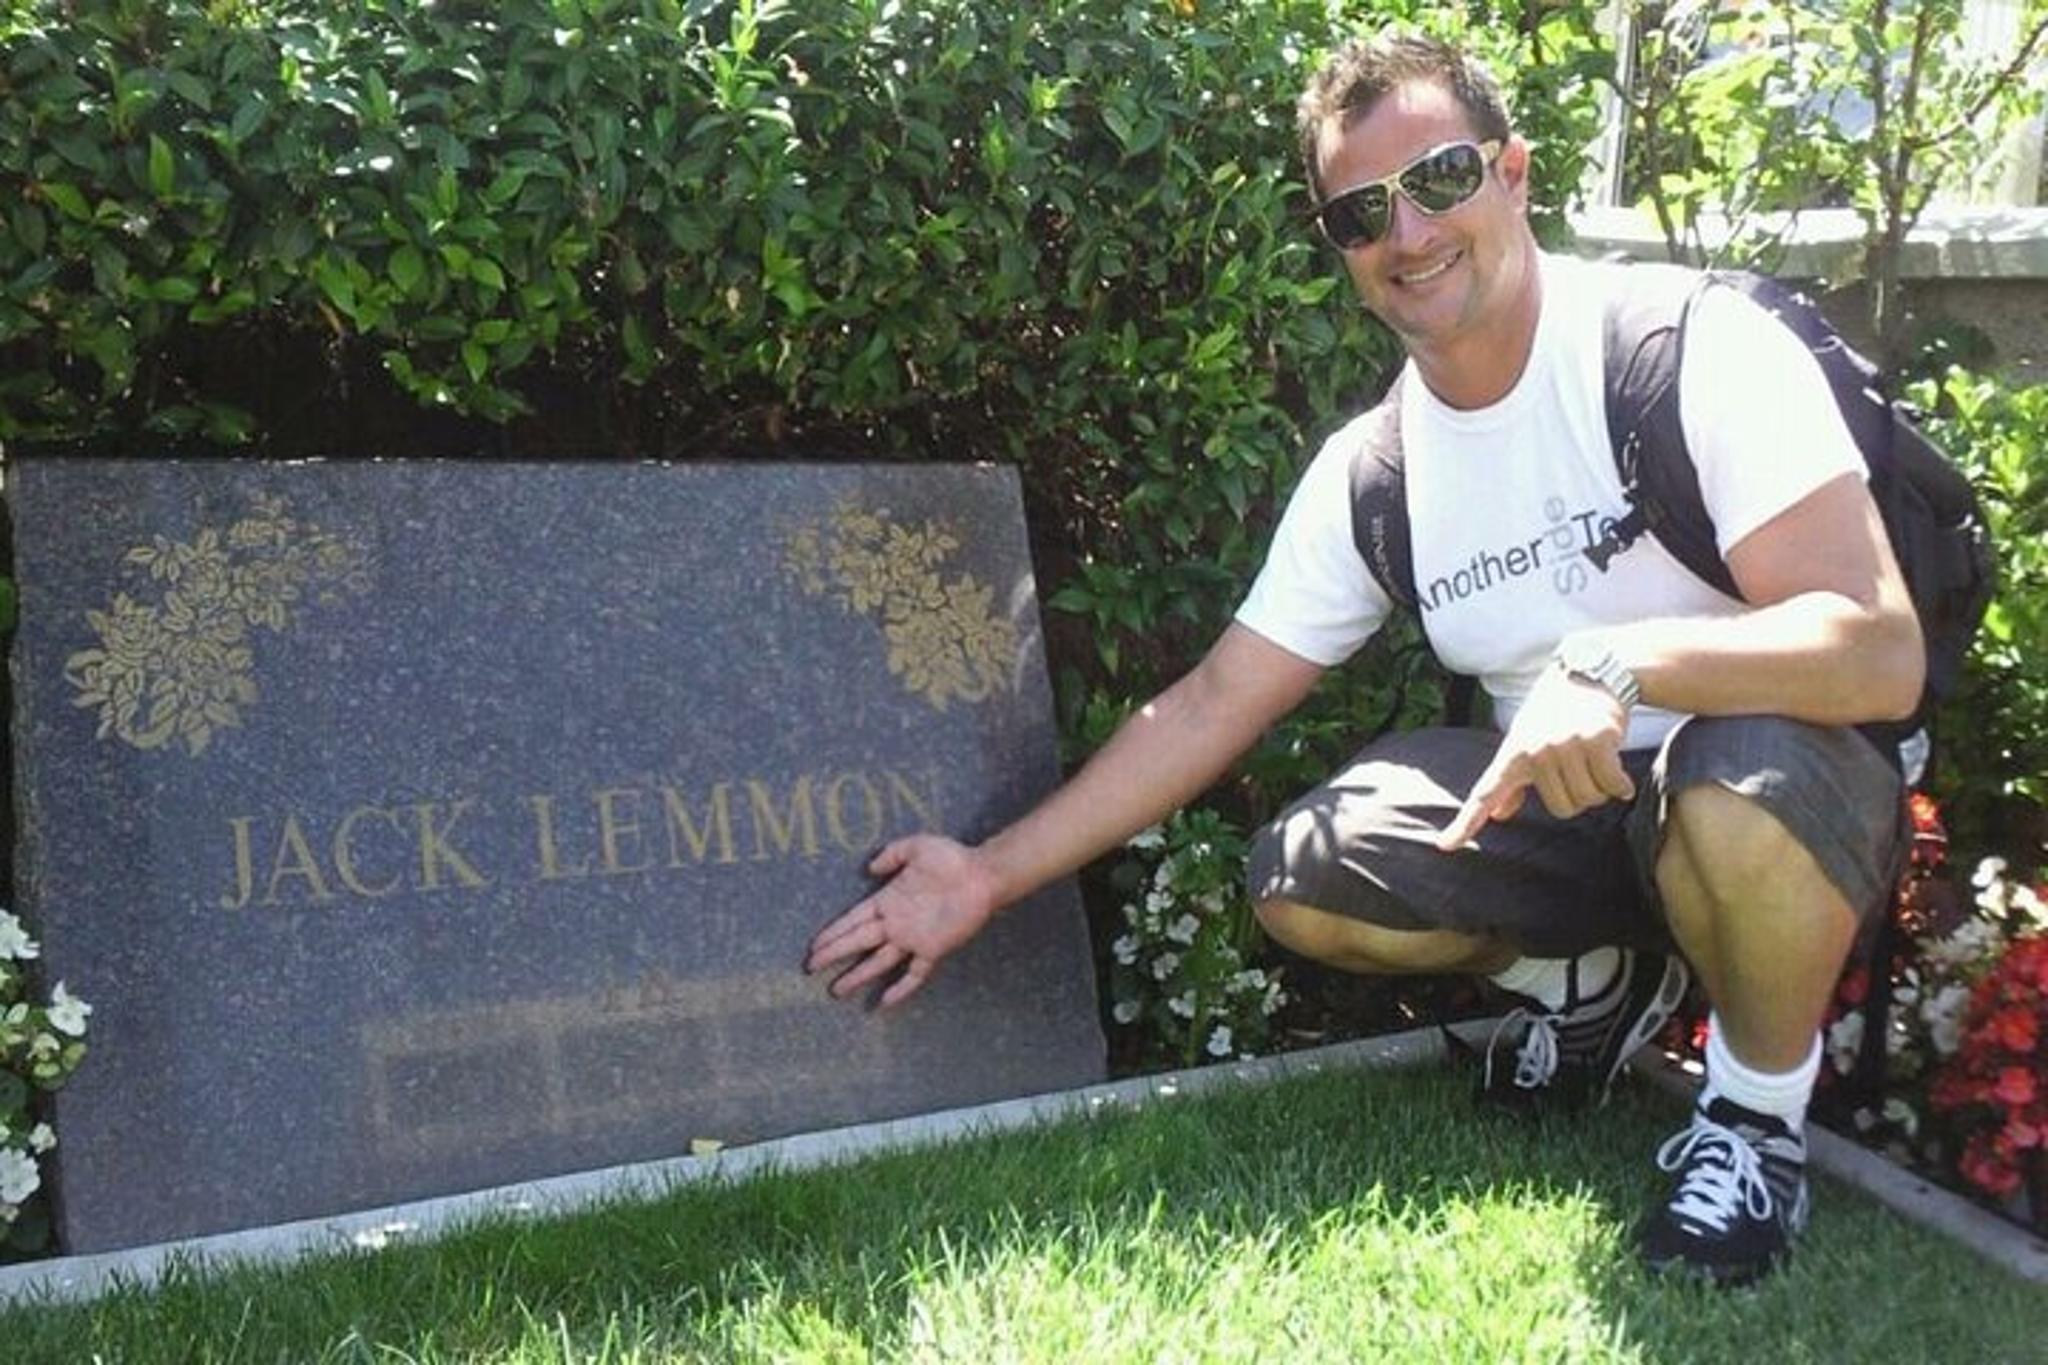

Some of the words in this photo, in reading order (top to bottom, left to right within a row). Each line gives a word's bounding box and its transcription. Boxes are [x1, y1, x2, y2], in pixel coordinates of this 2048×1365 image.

[1544, 496, 1588, 595] Side
[219, 797, 500, 910] JACK
[529, 768, 943, 881] LEMMON
